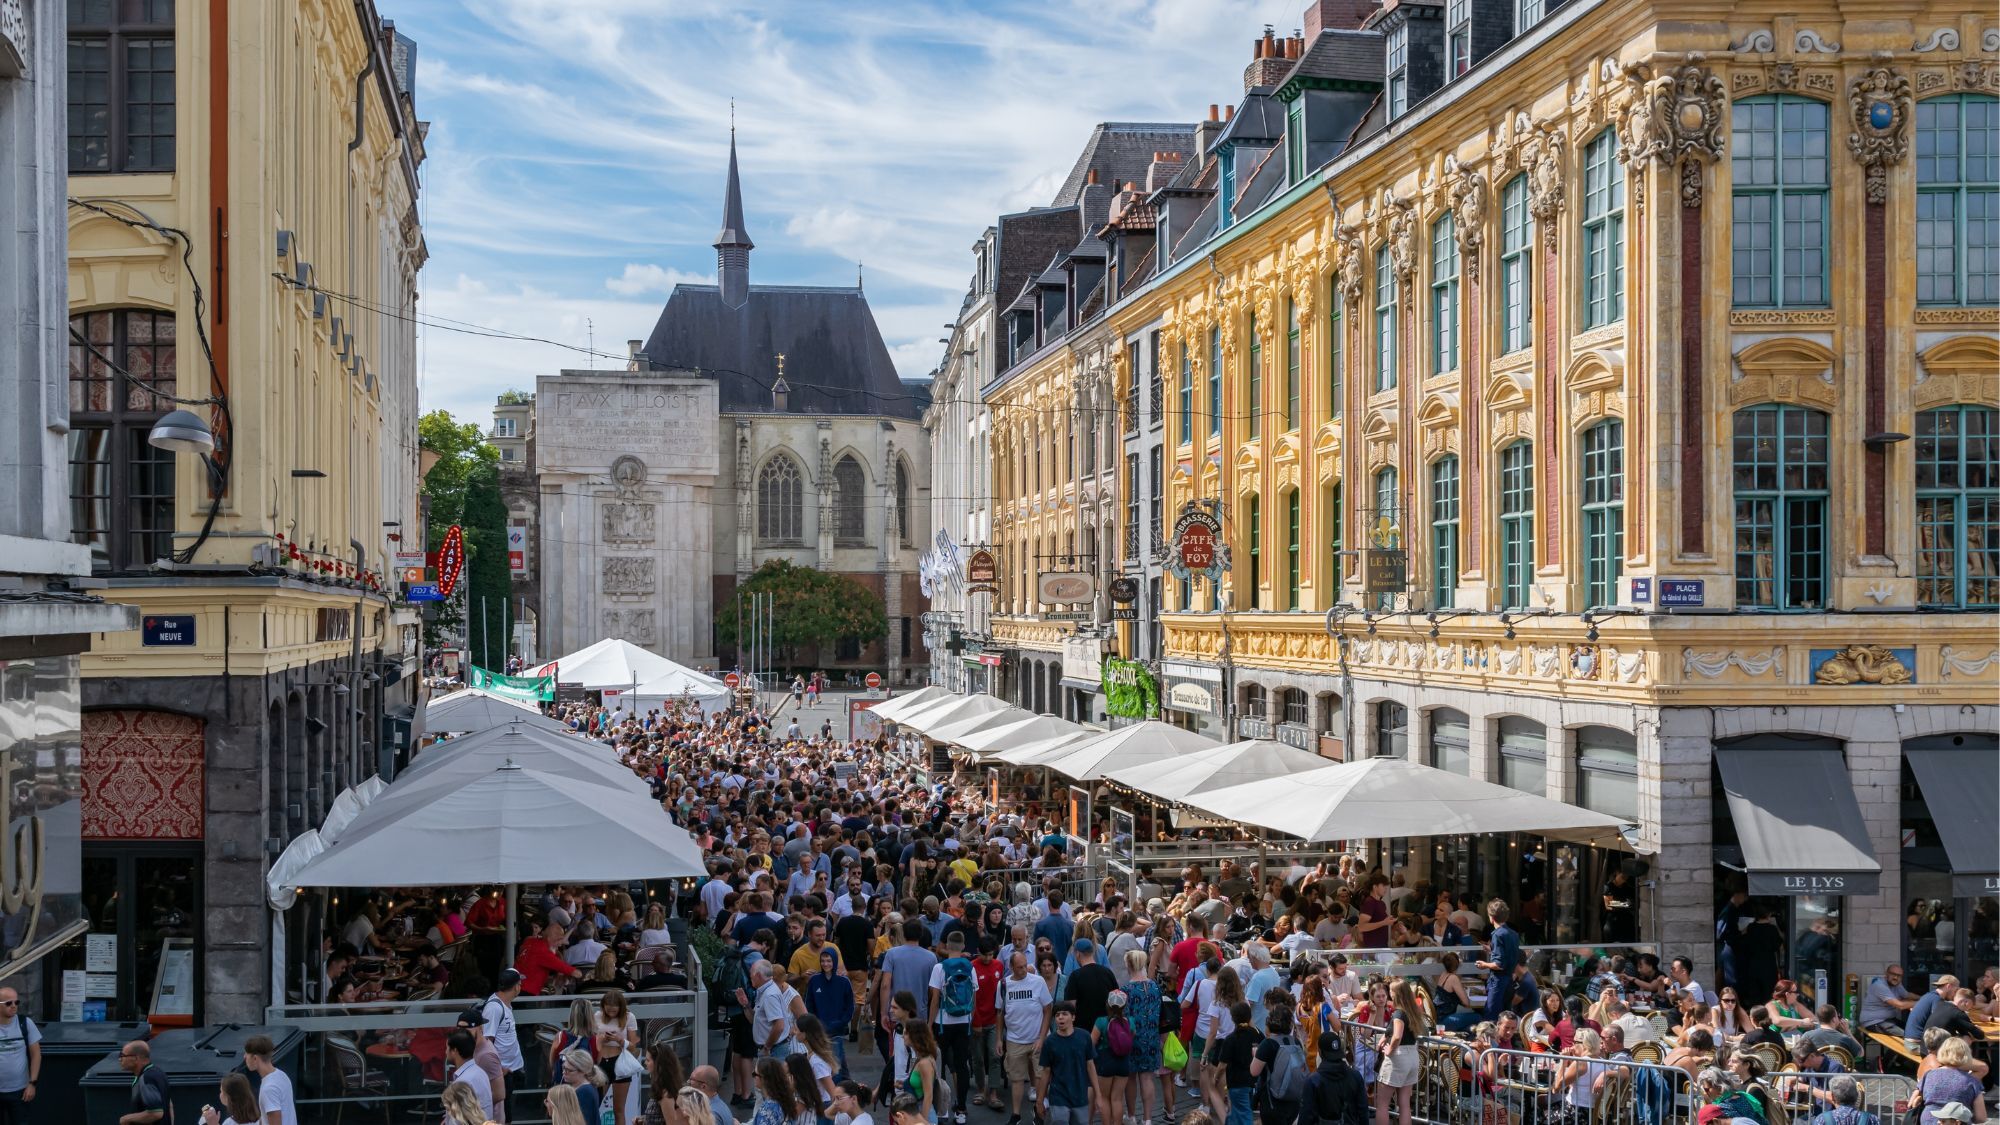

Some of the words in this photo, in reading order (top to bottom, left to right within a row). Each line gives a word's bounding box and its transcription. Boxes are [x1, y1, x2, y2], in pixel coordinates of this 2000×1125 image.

[576, 393, 610, 408] AVX
[620, 394, 681, 409] LILLOIS
[1177, 514, 1219, 532] BRASSERIE
[444, 540, 456, 582] TABAC
[1370, 556, 1383, 567] LE
[1385, 556, 1405, 567] LYS
[1044, 612, 1090, 621] Kronenbourg
[1113, 610, 1135, 618] BAR
[164, 620, 177, 629] Rue
[159, 632, 182, 641] NEUVE
[1173, 690, 1194, 704] Brasserie
[1194, 693, 1200, 705] de
[1200, 694, 1209, 709] Foy
[1276, 727, 1287, 743] de
[1783, 876, 1806, 887] LE
[1812, 876, 1844, 888] LYS
[1008, 990, 1033, 1000] PUMA
